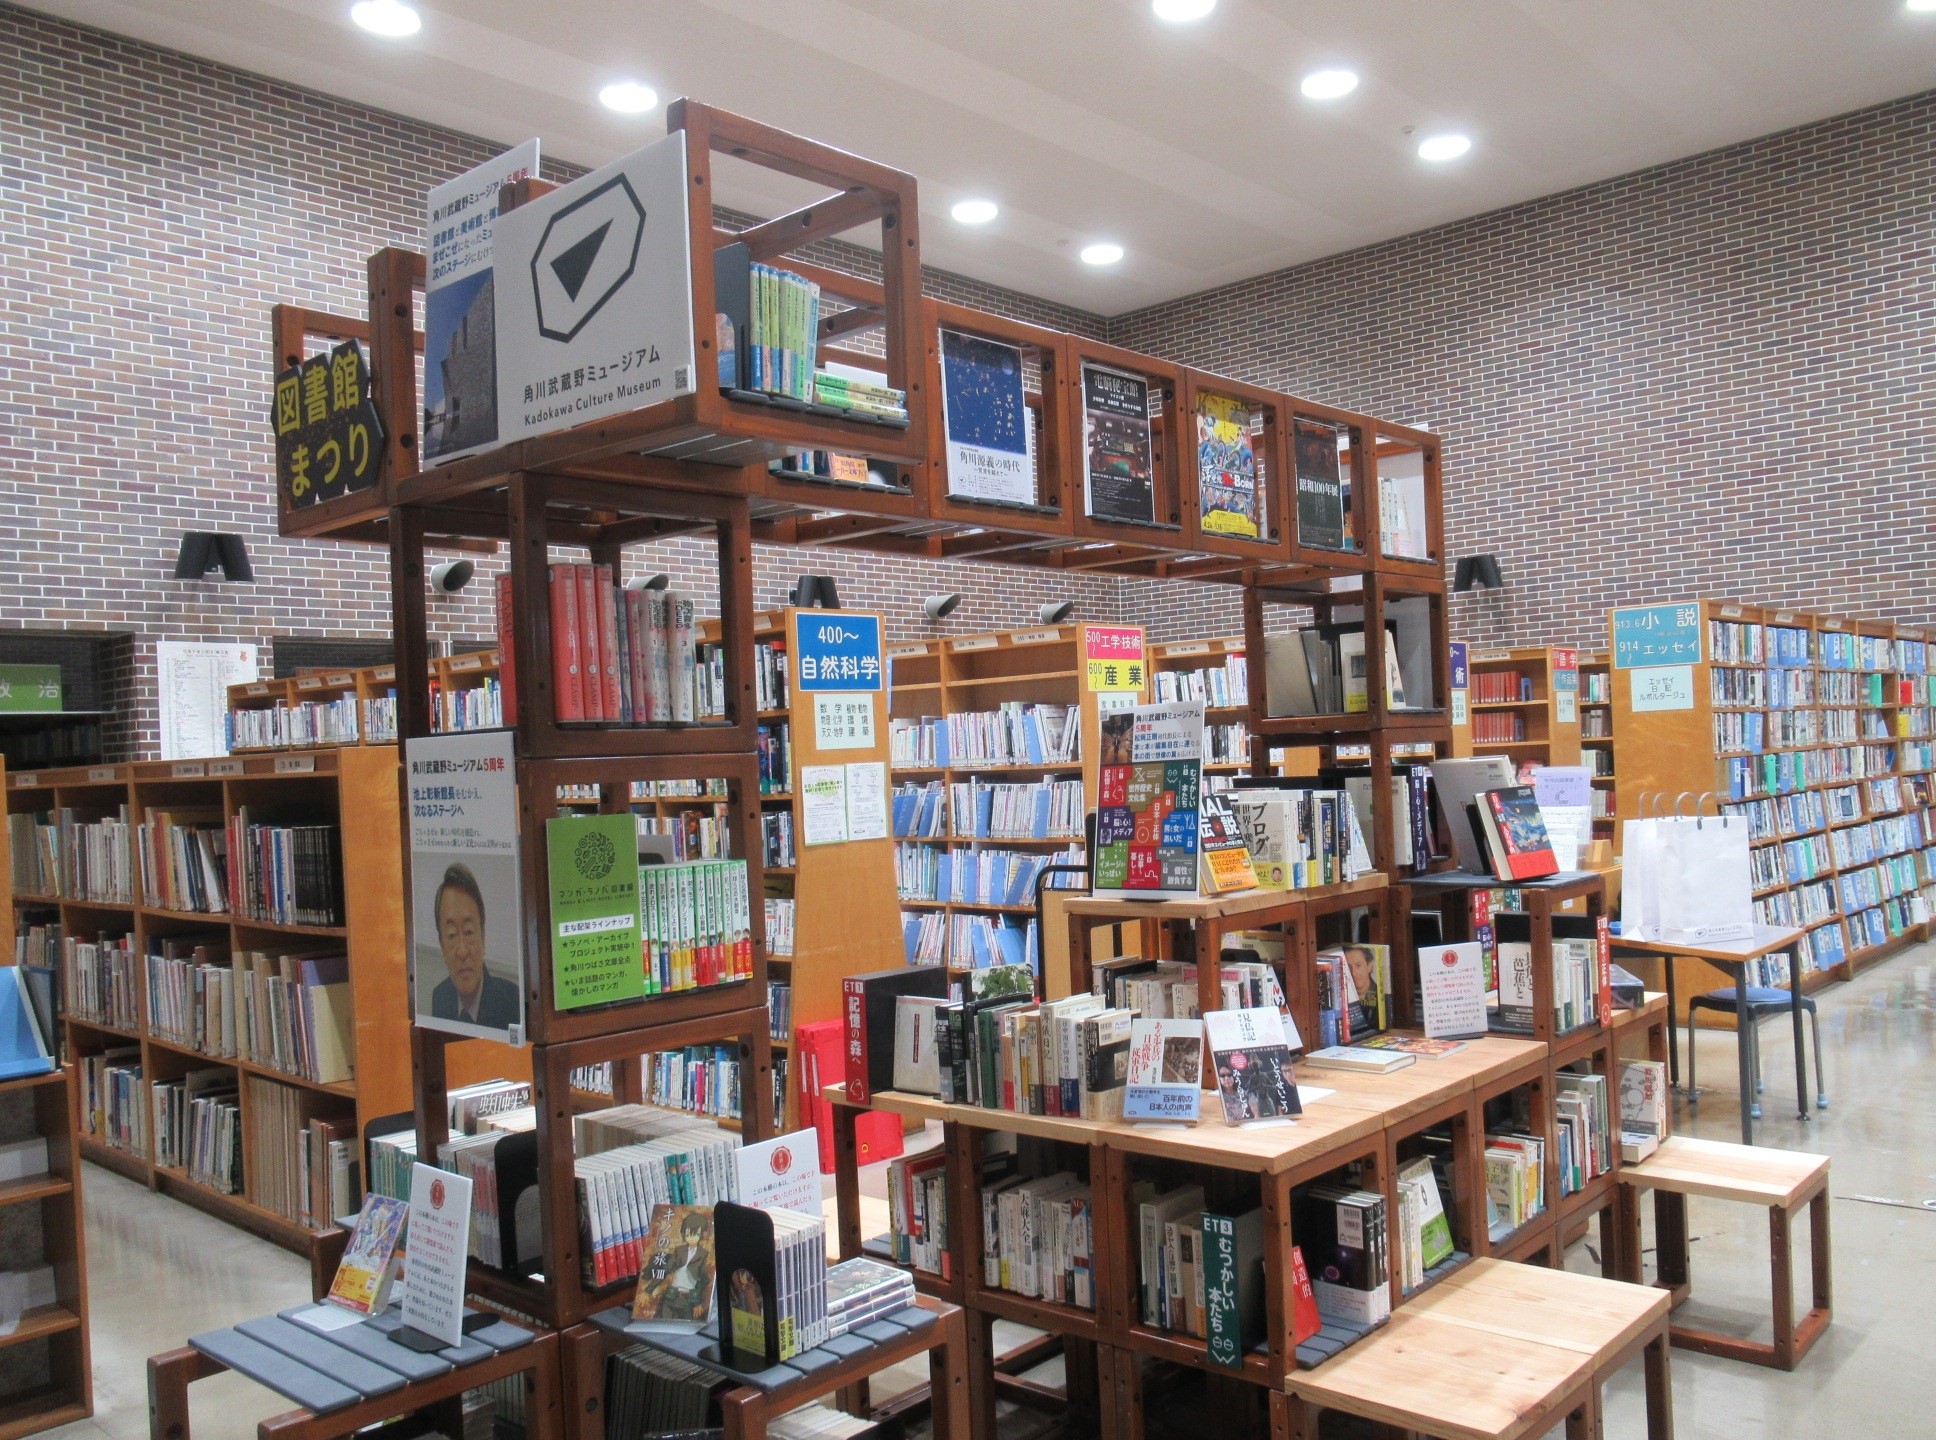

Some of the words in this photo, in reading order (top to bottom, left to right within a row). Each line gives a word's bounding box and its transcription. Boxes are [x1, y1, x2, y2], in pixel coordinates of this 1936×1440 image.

[523, 345, 661, 405] 角川武蔵野ミュージアム
[276, 349, 359, 438] 図書館
[524, 401, 574, 426] Kadokawa
[576, 390, 614, 415] Culture
[617, 376, 662, 401] Museum
[290, 425, 369, 498] まつり
[1101, 635, 1141, 650] 工学・技術
[1620, 640, 1639, 653] 914
[1643, 640, 1697, 655] エッセイ
[802, 656, 879, 680] 自然科学
[1649, 676, 1675, 685] エッセイ
[1640, 692, 1686, 701] ルポルタージュ
[1136, 710, 1200, 723] 角川武蔵野ミュージアム
[1136, 724, 1153, 732] 5周年
[1189, 769, 1197, 808] むつかしい
[414, 805, 465, 817] 次なるステージへ
[1113, 828, 1133, 836] メディア
[1252, 802, 1270, 857] ブログ
[1163, 834, 1183, 843] あいだ
[1099, 869, 1121, 878] いっぱい
[563, 917, 631, 933] 主な配架ラインナップ
[570, 956, 631, 972] 角川つばさ文庫全点
[571, 982, 619, 996] 懐かしのマンガ
[848, 996, 862, 1065] 記憶の森へ
[1269, 1057, 1289, 1113] いとうせいこう
[1163, 1094, 1193, 1103] 百年前の
[1149, 1102, 1192, 1112] 日本人の肉声
[1021, 1193, 1031, 1244] 大麻大全
[653, 1208, 675, 1266] キノの旅
[1218, 1236, 1235, 1310] むつかしい
[1208, 1287, 1223, 1333] 本たち
